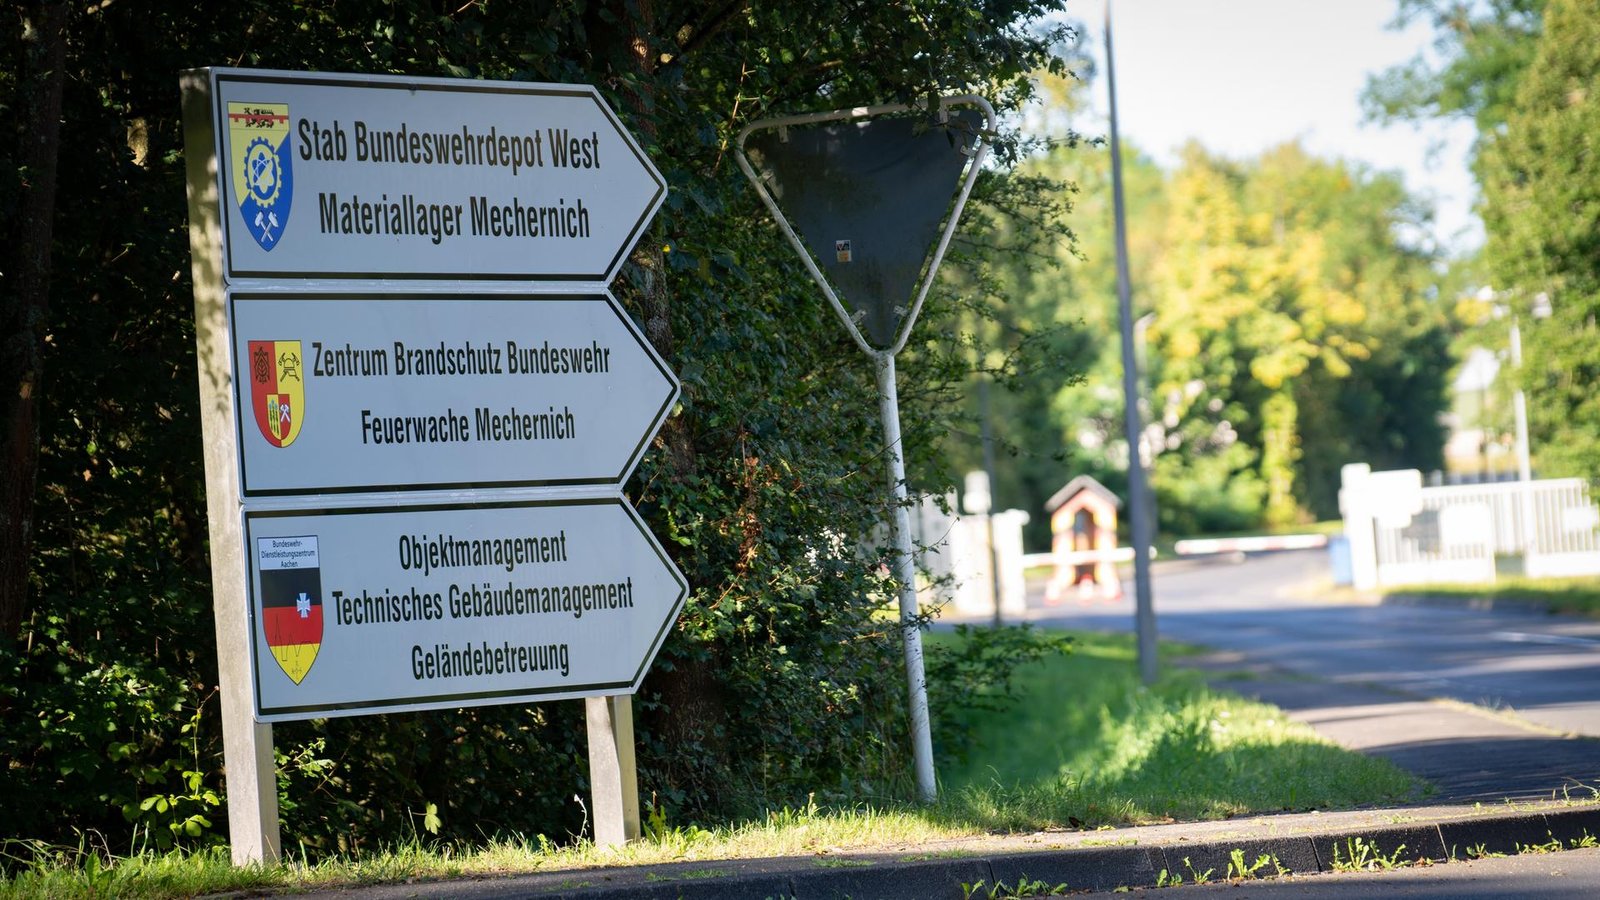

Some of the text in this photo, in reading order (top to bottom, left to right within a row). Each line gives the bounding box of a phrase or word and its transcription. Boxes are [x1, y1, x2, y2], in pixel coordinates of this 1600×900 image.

[299, 118, 600, 175] Stab Bundeswehrdepot West
[318, 192, 590, 245] Materiallager Mechernich
[312, 340, 610, 377] Zentrum Brandschutz Bundeswehr
[361, 406, 575, 444] Feuerwache Mechernich
[261, 550, 316, 559] Dienstleistungszentrum
[272, 540, 303, 548] Bundeswehr-
[399, 530, 567, 577] Objektmanagement
[281, 560, 298, 568] Aachen
[332, 576, 634, 626] Technisches Gebäudemanagement
[412, 641, 569, 681] Geländebetreuung
